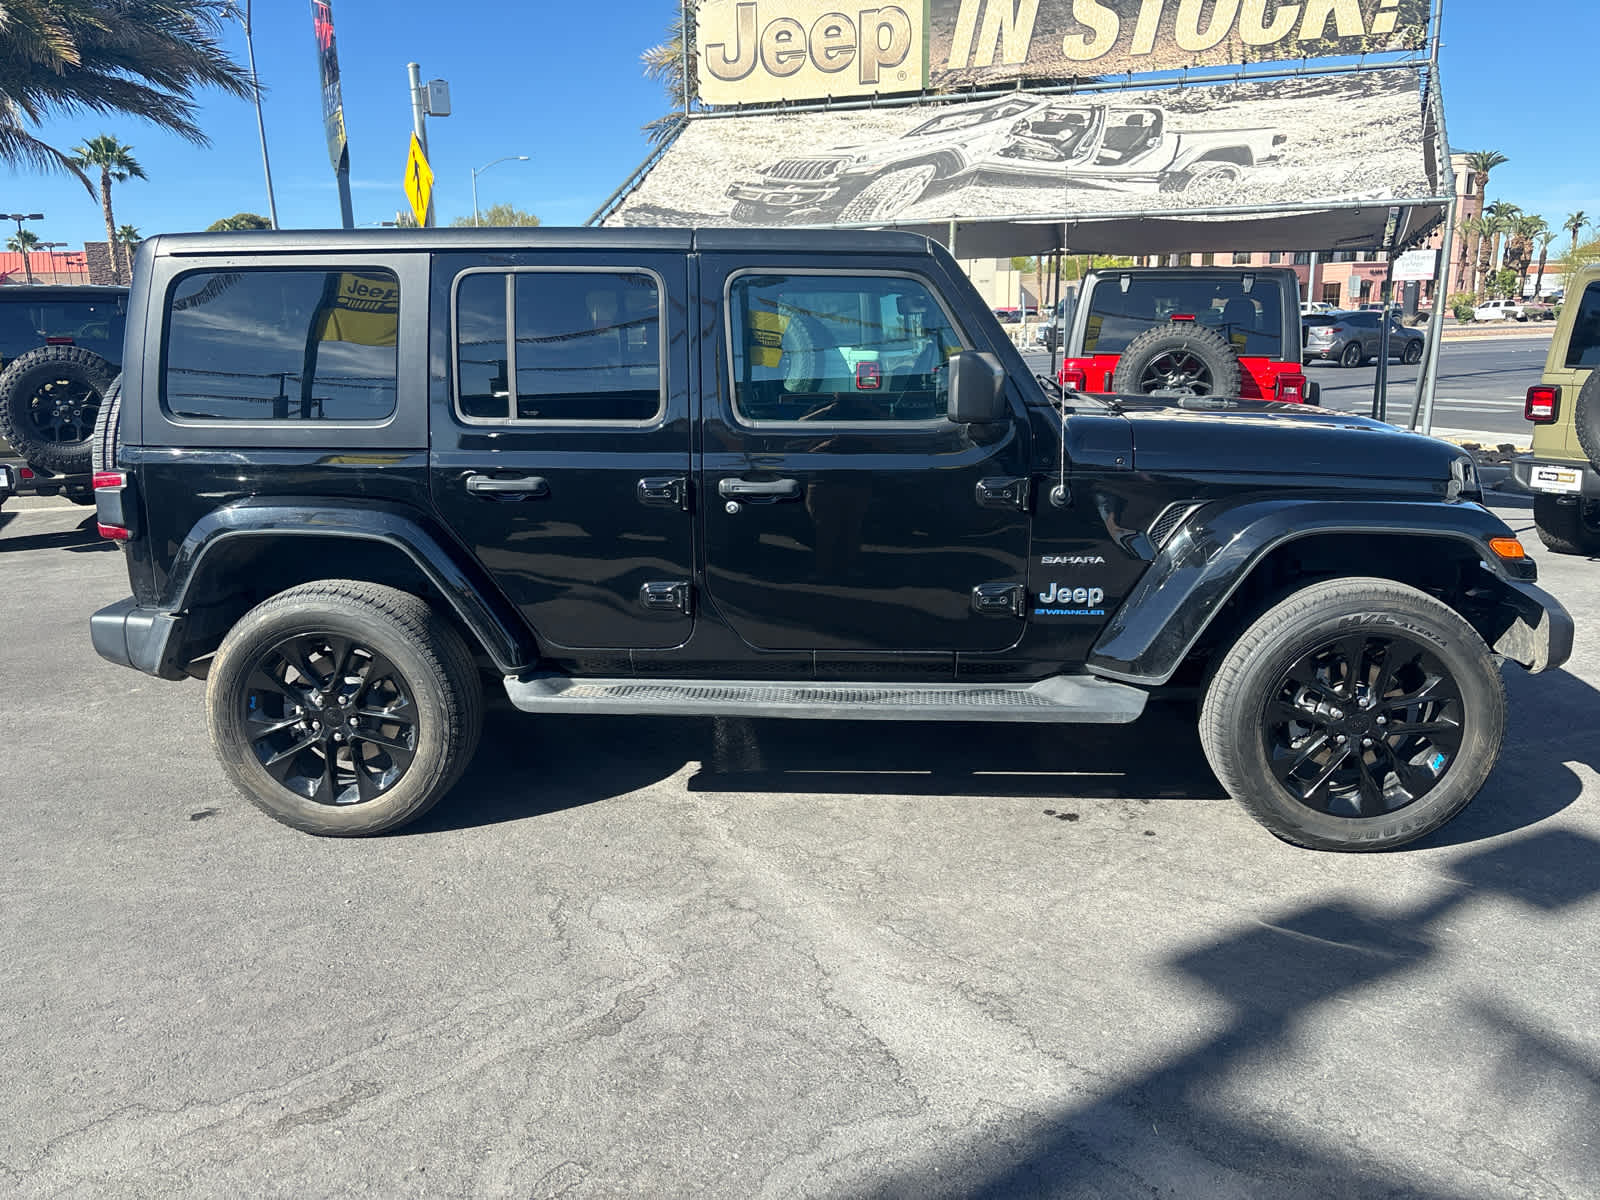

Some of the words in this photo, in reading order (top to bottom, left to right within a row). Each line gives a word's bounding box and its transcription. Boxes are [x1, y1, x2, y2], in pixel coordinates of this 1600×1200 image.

[705, 2, 912, 85] Jeep
[947, 0, 1039, 70] IN
[1040, 556, 1106, 564] SAHARA
[1039, 582, 1104, 608] Jeep
[1046, 608, 1105, 616] WRANGLER
[1400, 622, 1448, 647] ALENZA
